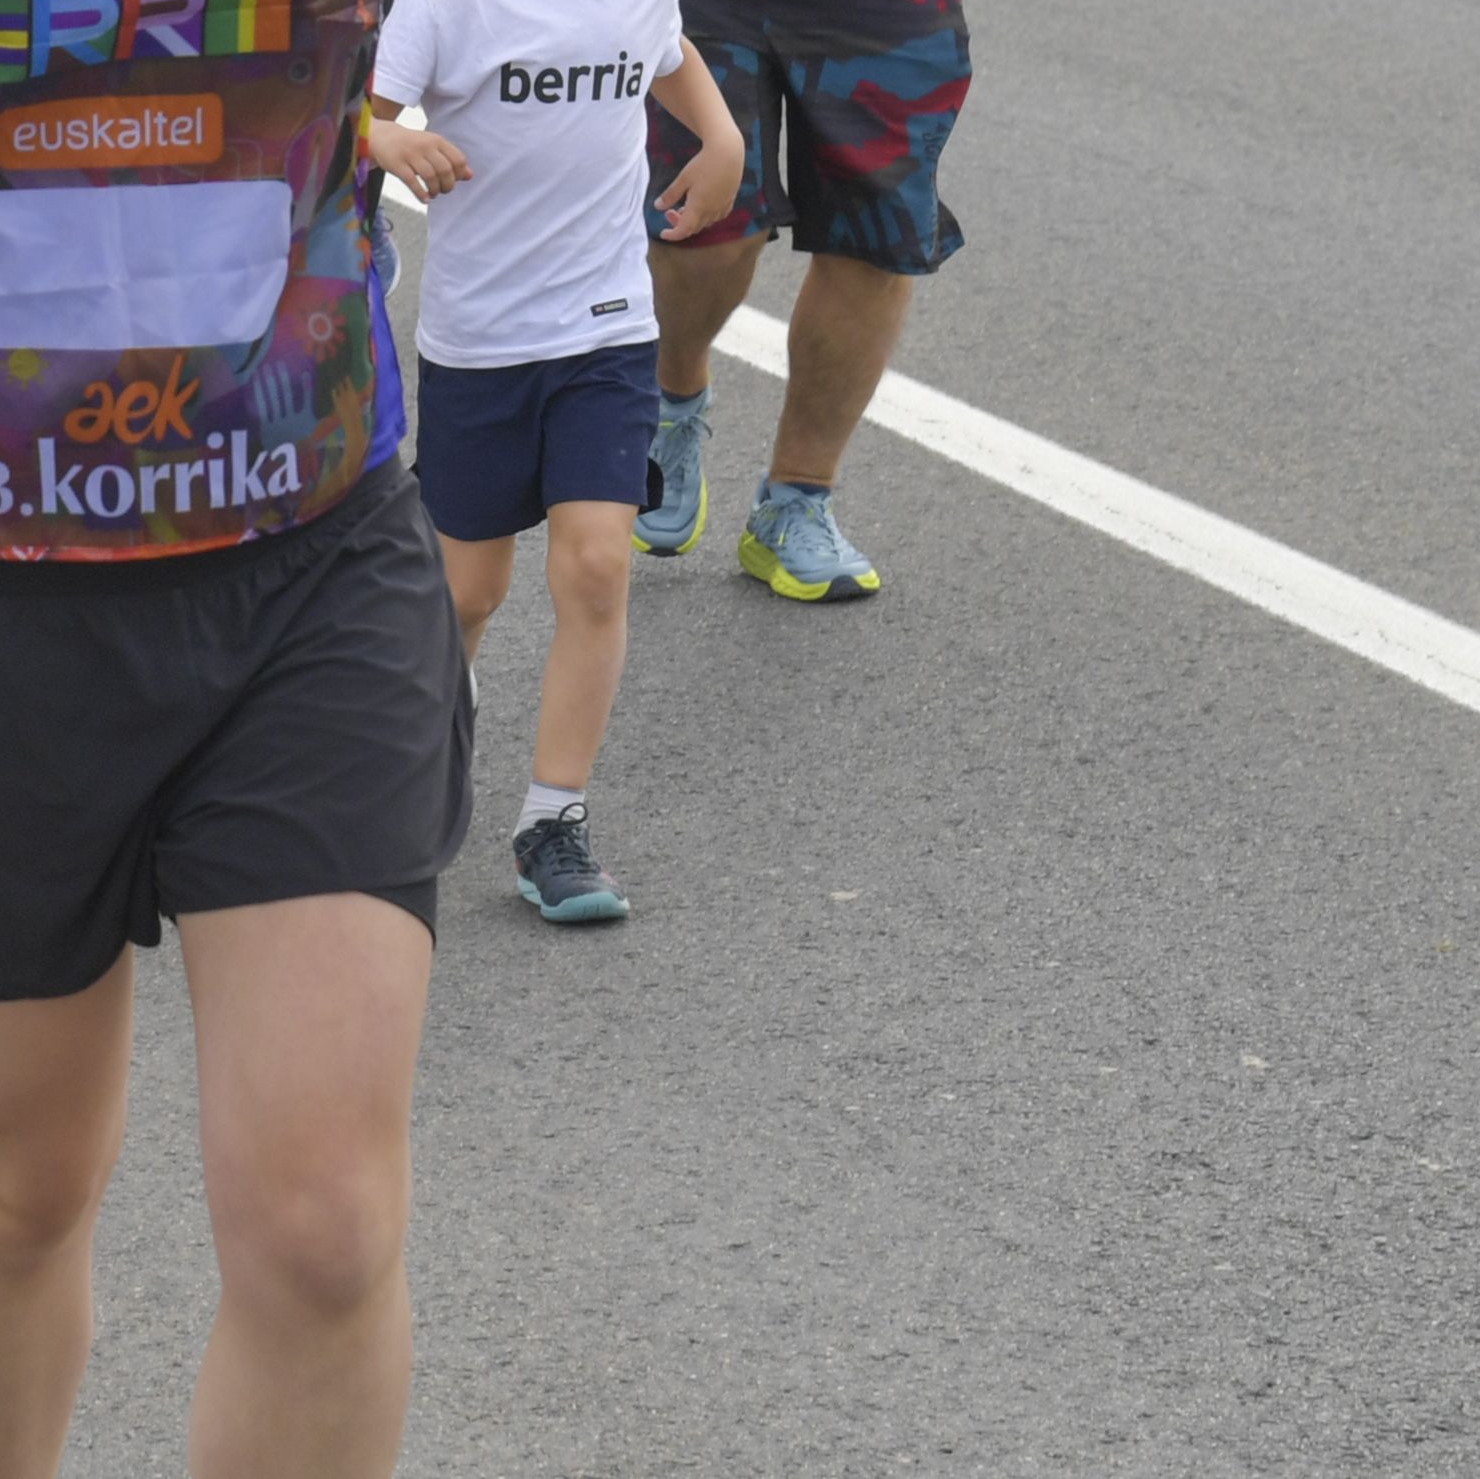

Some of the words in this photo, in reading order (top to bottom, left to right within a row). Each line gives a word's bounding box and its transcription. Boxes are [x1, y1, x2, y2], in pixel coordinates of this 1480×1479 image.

[499, 51, 644, 104] berria
[13, 107, 205, 153] euskaltel
[63, 352, 200, 445] aek
